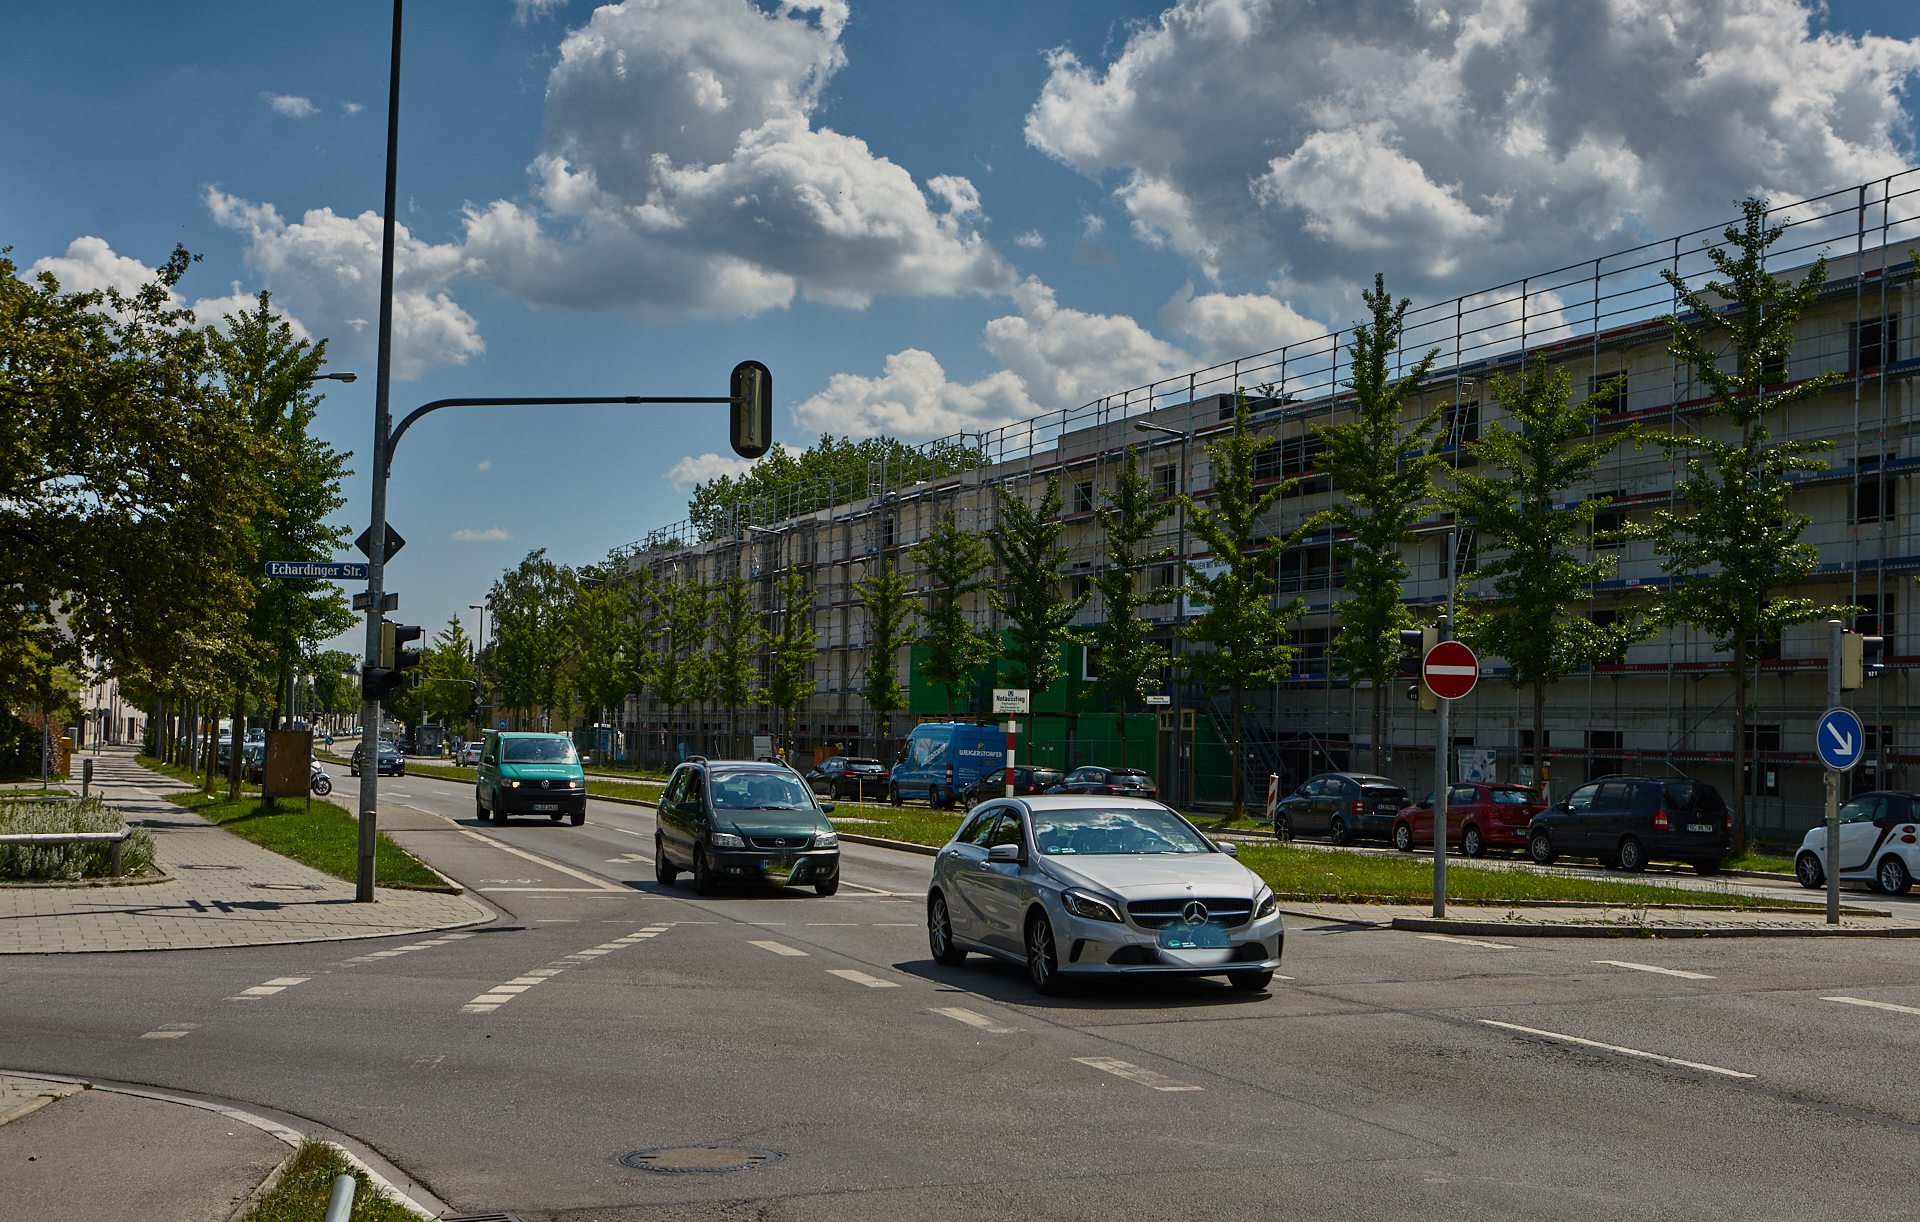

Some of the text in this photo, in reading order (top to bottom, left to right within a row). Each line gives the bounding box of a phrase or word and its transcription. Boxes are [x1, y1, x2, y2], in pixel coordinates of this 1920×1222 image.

[271, 563, 362, 577] Echardinger Str.
[996, 695, 1025, 703] Notausstieg
[959, 749, 1002, 757] WEIGERSTORFER
